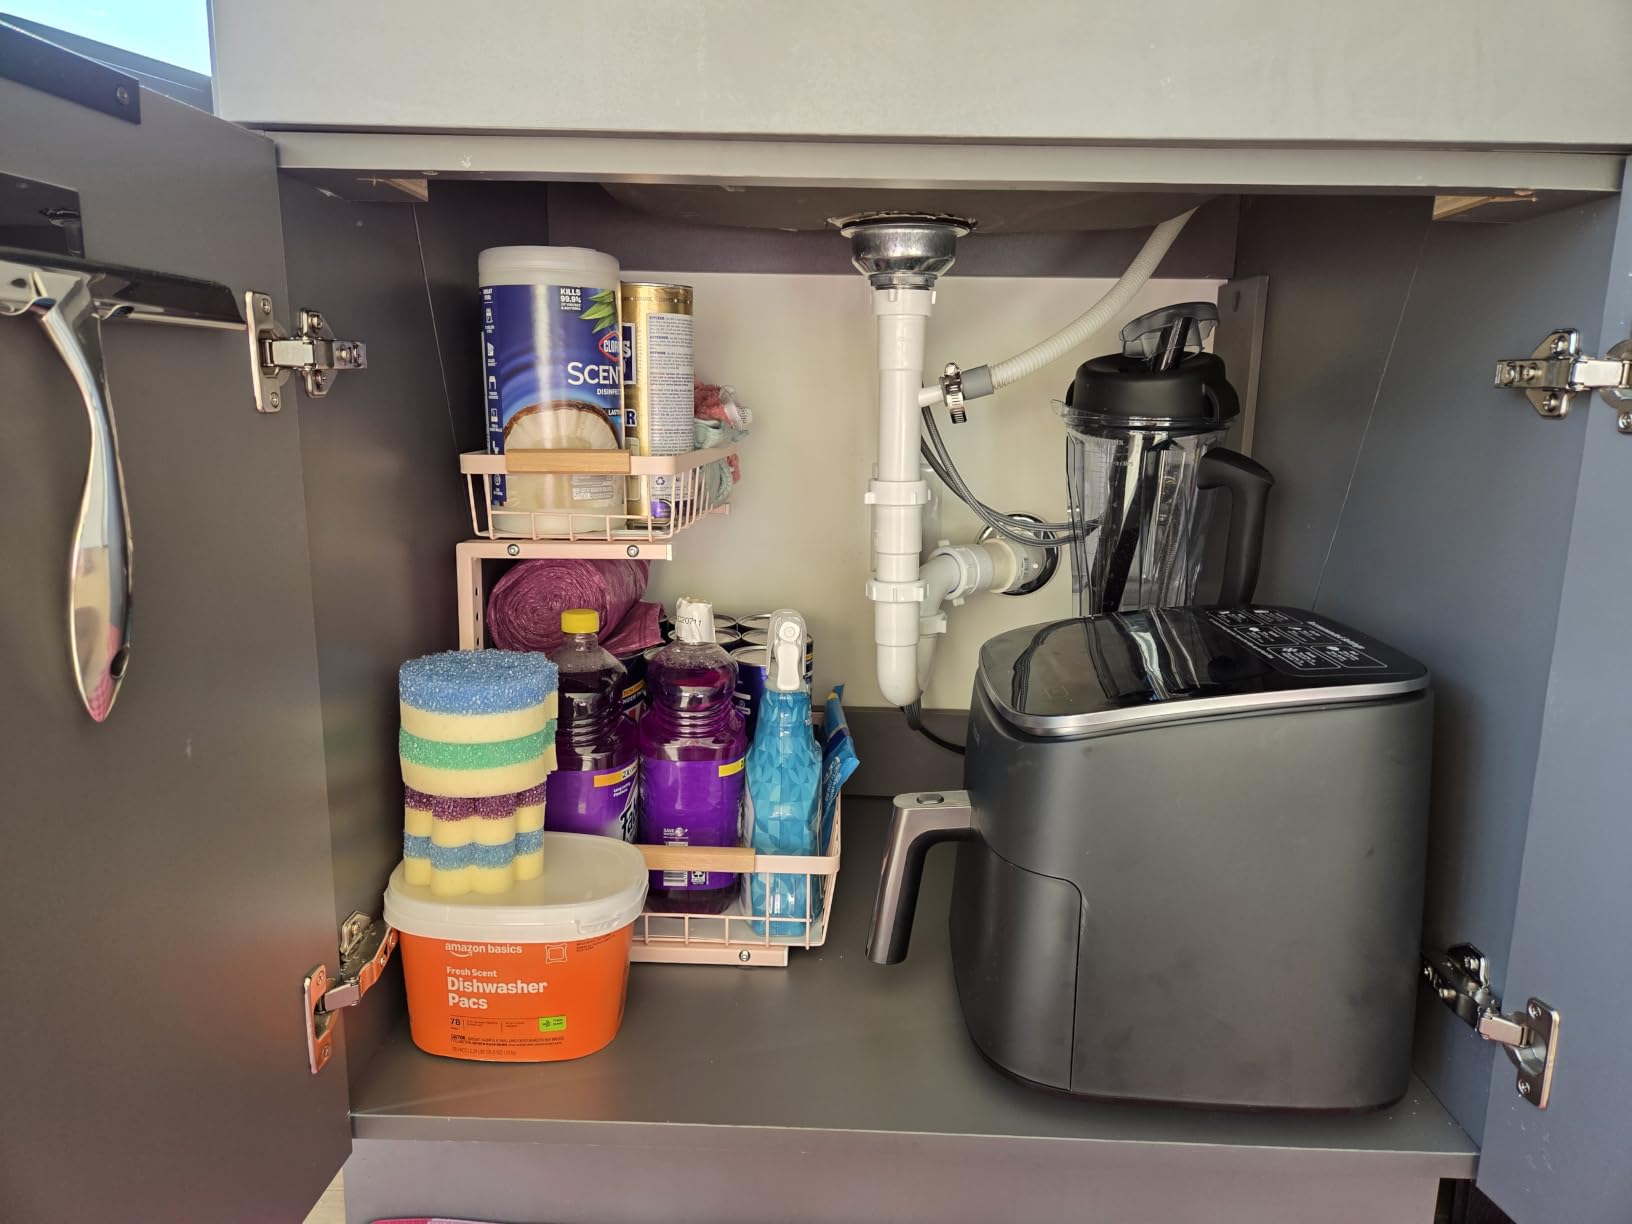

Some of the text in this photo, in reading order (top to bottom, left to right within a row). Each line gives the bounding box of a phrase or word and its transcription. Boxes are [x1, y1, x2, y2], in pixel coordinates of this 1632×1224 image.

[560, 287, 581, 295] KILLS
[560, 295, 582, 303] 99.9%
[567, 361, 620, 386] SCEN
[445, 942, 523, 954] amazon basics
[446, 966, 498, 978] Fresh Scent
[447, 976, 548, 994] Dishwasher
[448, 992, 488, 1009] Pacs
